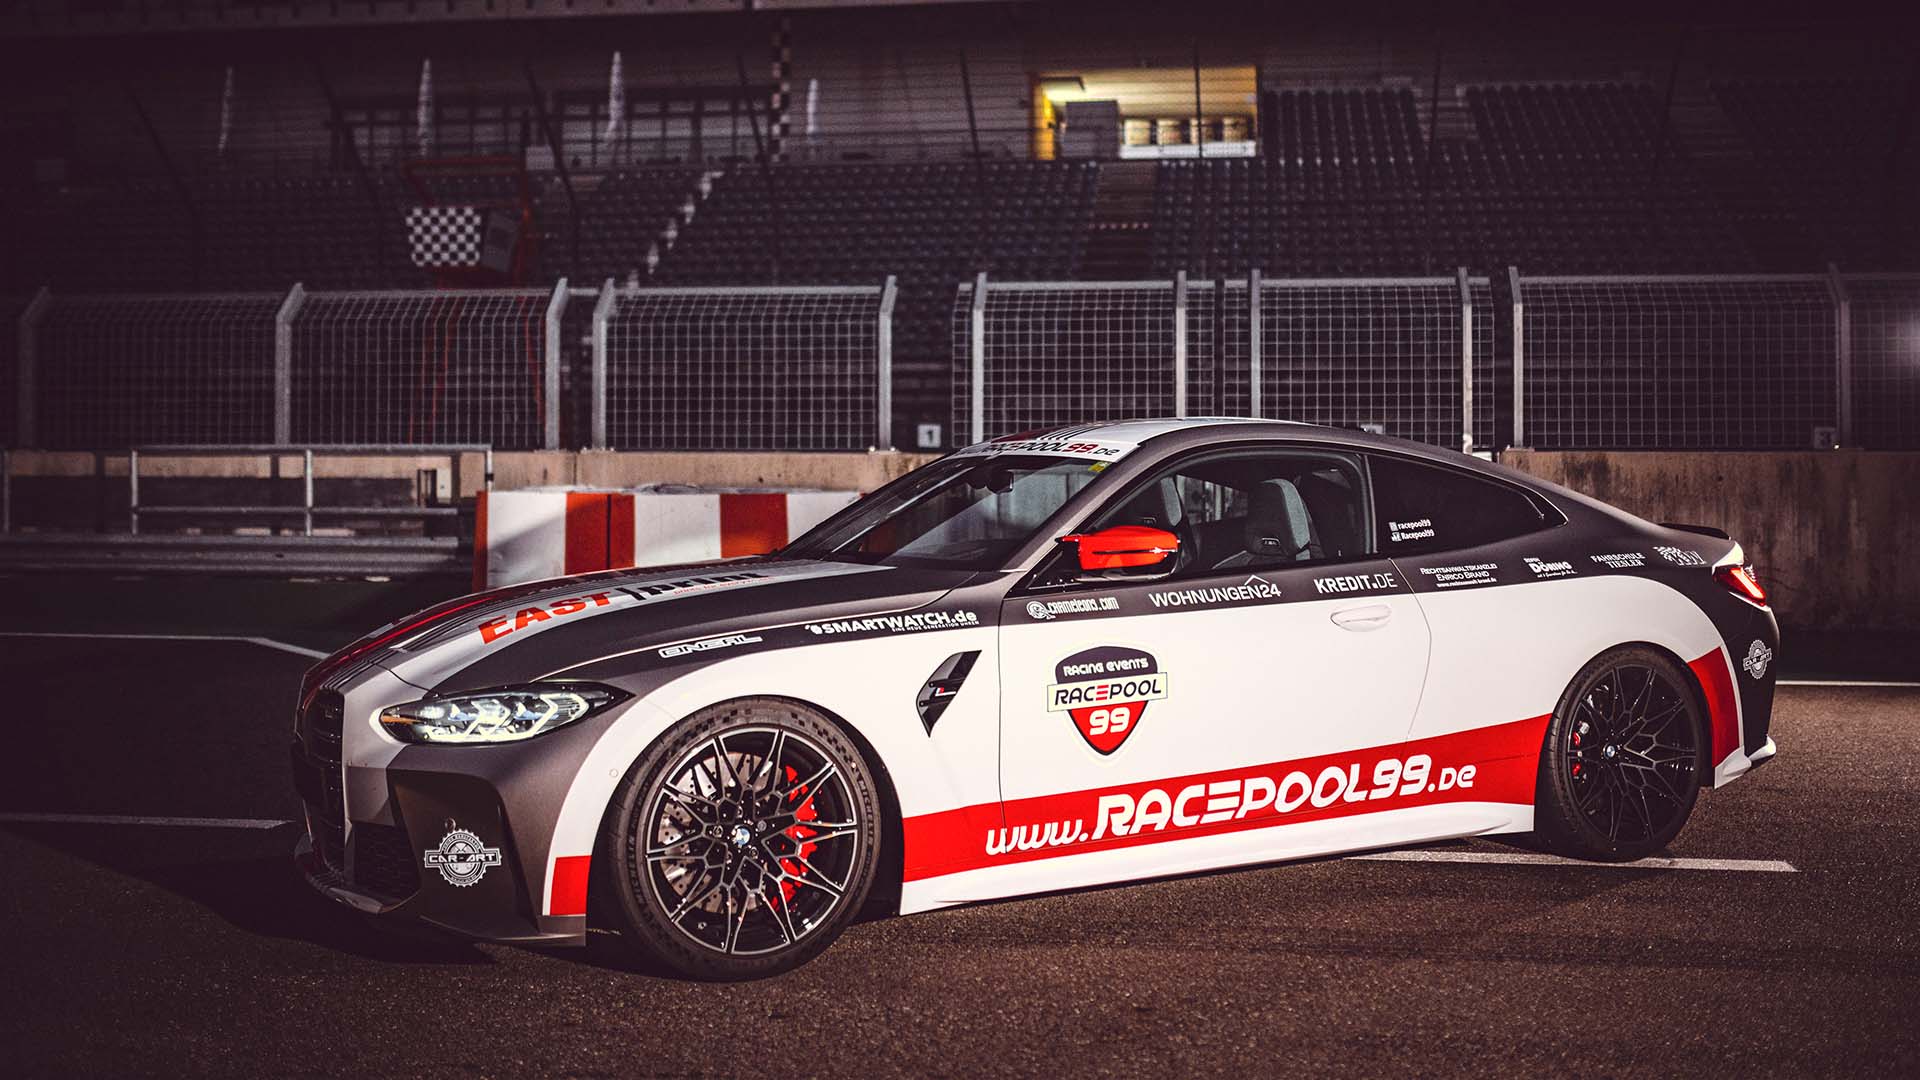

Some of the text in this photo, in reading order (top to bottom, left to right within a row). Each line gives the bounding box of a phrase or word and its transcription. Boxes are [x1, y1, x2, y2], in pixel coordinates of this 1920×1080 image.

[926, 429, 934, 445] 1
[1528, 561, 1573, 573] DÖRING
[1590, 552, 1646, 562] FAHRSCHULE
[1605, 559, 1645, 569] TIESLER
[1313, 573, 1398, 594] KREDIT.DE
[1149, 583, 1282, 608] WOHNUNGEN24
[477, 590, 612, 645] EAST
[822, 610, 977, 634] SMARTWATCH.de
[1063, 662, 1104, 677] RACING
[1054, 678, 1162, 706] RACEPOOL
[1089, 706, 1131, 736] 99
